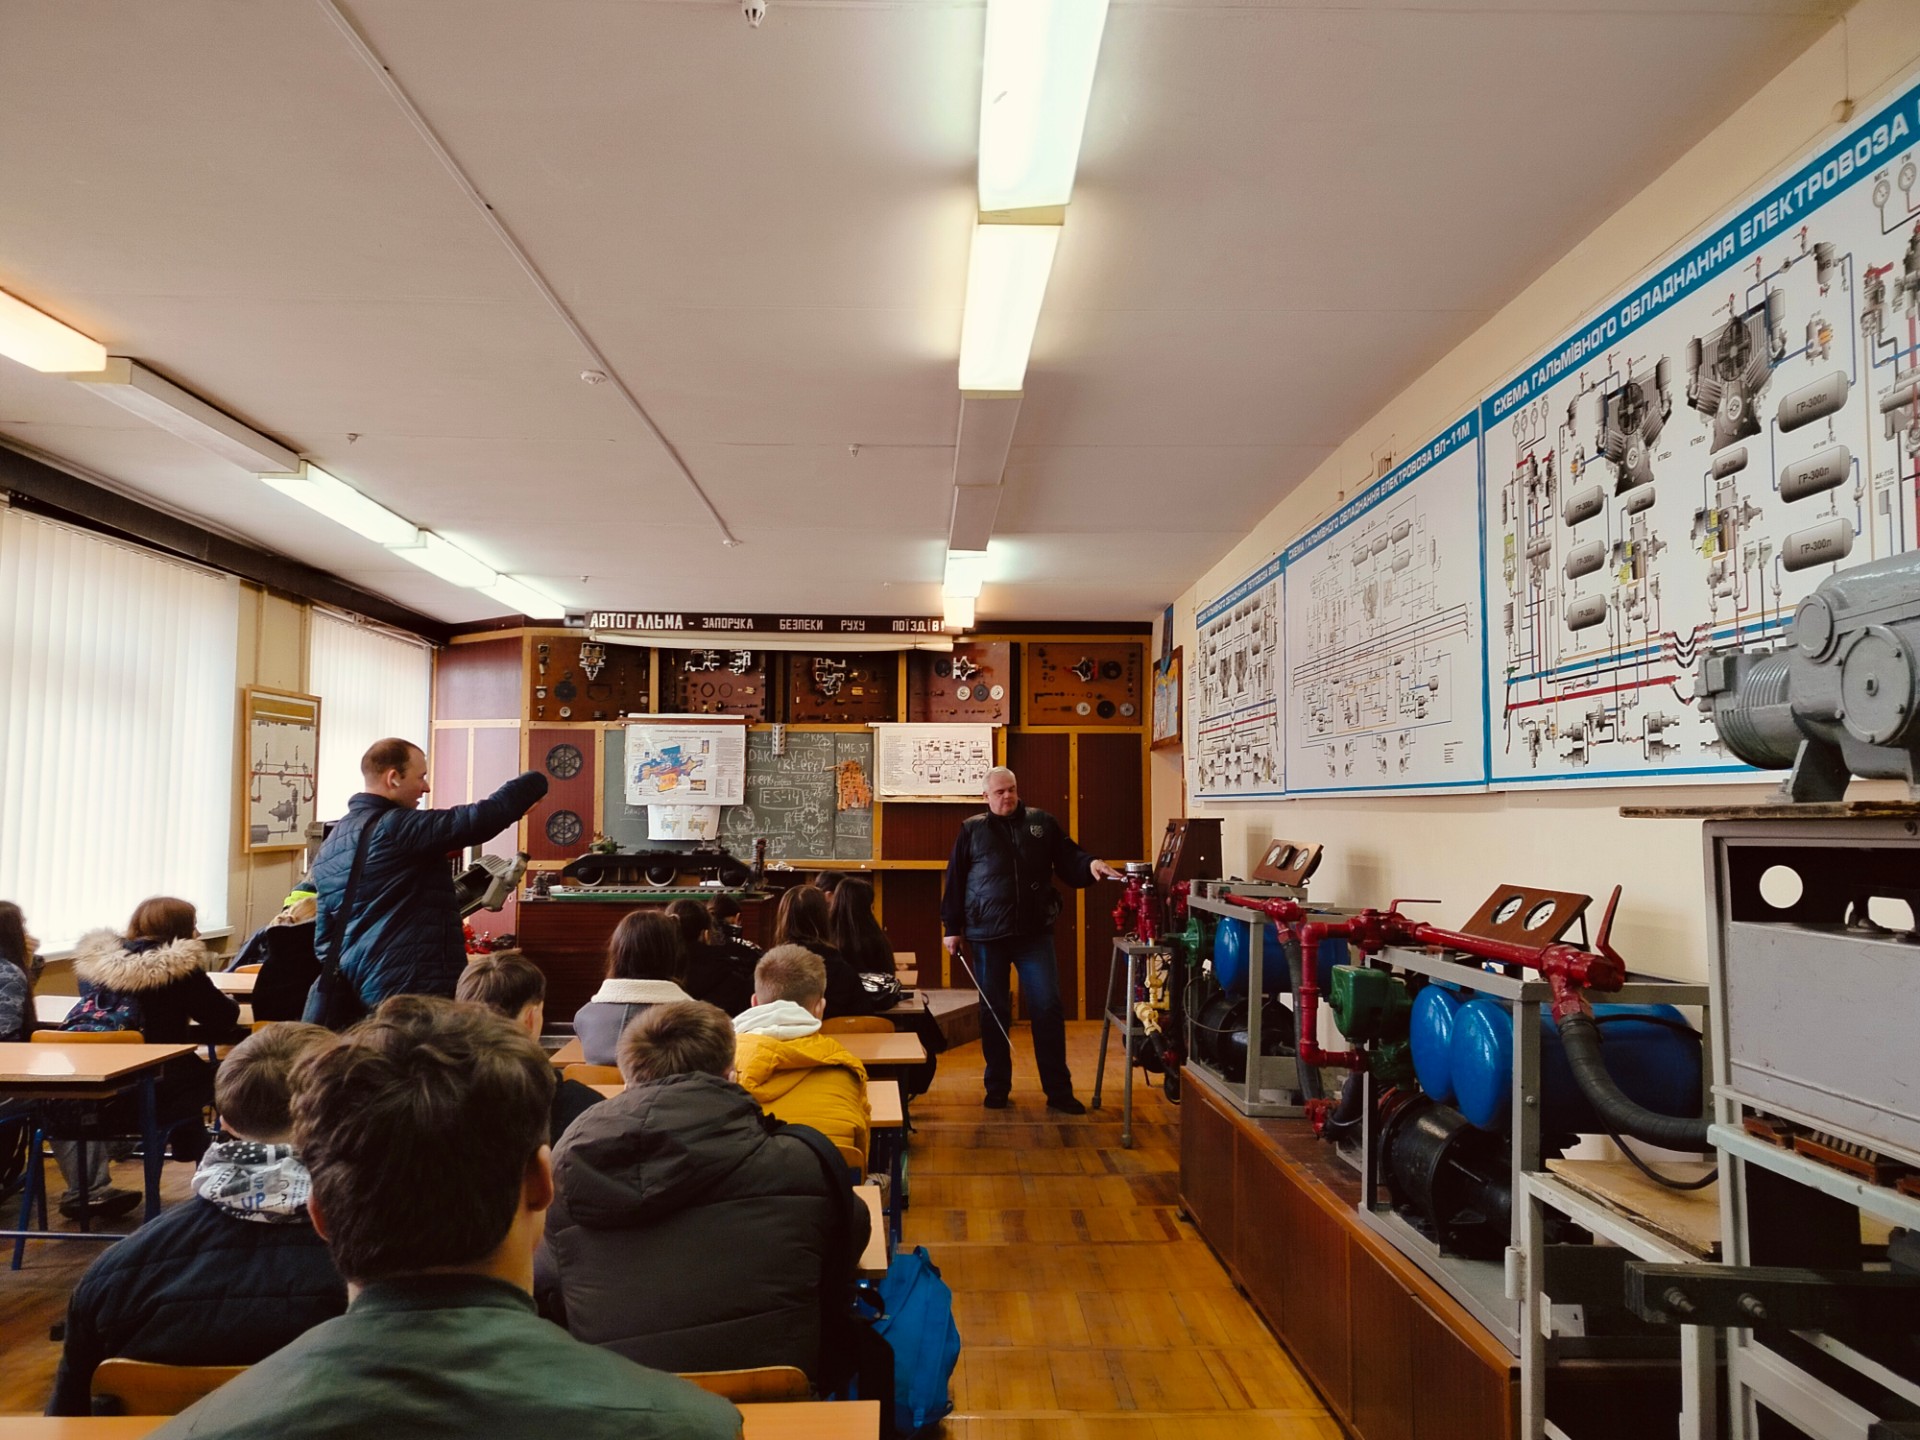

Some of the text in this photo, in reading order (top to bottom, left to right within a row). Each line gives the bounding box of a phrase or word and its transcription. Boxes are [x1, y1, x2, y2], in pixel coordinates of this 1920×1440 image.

[1494, 112, 1910, 417] СХЕМА ГАЛЬМІВНОГО ОБЛАДНАННЯ ЕЛЕКТРОВОЗА
[590, 613, 683, 629] АВТОГАЛЬМА
[702, 617, 754, 629] ЗАПОРУКА
[779, 619, 823, 631] БЕЗПЕКИ
[840, 620, 865, 631] РУХУ
